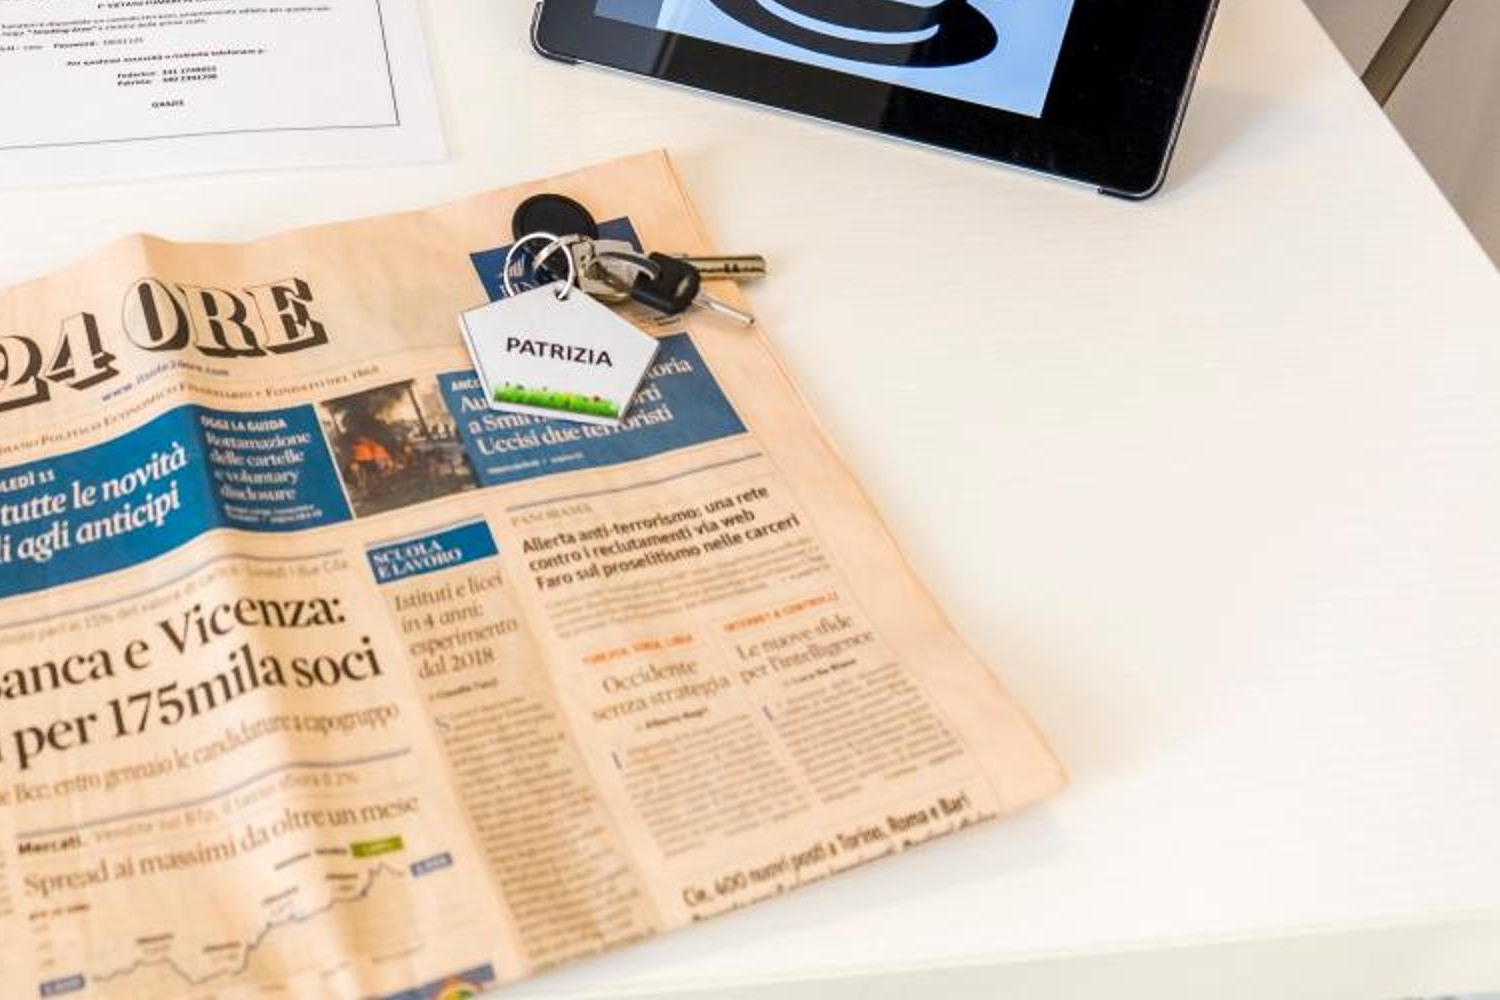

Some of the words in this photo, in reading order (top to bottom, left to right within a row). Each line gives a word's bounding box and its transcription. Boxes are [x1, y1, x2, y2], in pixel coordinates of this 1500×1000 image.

[122, 276, 328, 358] ORE
[506, 337, 613, 367] PATRIZIA
[201, 415, 229, 430] OGGI
[231, 418, 245, 430] LA
[247, 417, 288, 431] GUIDA
[468, 421, 483, 435] a
[205, 431, 311, 450] Rottamazione
[210, 448, 244, 466] delle
[246, 449, 305, 466] cartelle
[477, 432, 541, 456] Uccisi
[542, 426, 580, 445] due
[0, 488, 66, 527] tutte
[72, 480, 97, 509] le
[102, 441, 188, 501] novità
[39, 470, 55, 484] 11
[220, 486, 296, 501] disclosure
[226, 469, 299, 486] voluntary
[17, 521, 69, 562] agli
[76, 480, 180, 545] anticipi
[510, 503, 594, 528] PANORAMA
[522, 531, 576, 553] Allerta
[578, 507, 702, 543] anti-terrorismo:
[705, 497, 734, 514] una
[737, 485, 769, 505] rete
[373, 539, 443, 563] SCUOLA
[529, 551, 582, 573] contro
[592, 527, 692, 558] reclutamenti
[695, 519, 719, 535] via
[722, 509, 755, 528] web
[536, 574, 573, 591] Faro
[575, 563, 600, 580] sul
[602, 544, 701, 579] proselitismo
[703, 533, 744, 554] nelle
[745, 512, 800, 541] carceri
[377, 564, 390, 579] E
[393, 548, 463, 575] LAVORO
[395, 583, 453, 611] Istituti
[455, 585, 466, 596] e
[468, 570, 503, 595] licei
[125, 637, 149, 670] e
[158, 596, 346, 655] Vicenza:
[402, 615, 421, 634] in
[424, 613, 435, 629] 4
[410, 618, 518, 657] esperimento
[736, 643, 760, 661] Le
[762, 630, 812, 654] nuove
[816, 613, 853, 636] sfide
[419, 654, 447, 679] dal
[451, 647, 495, 673] 2018
[602, 659, 698, 694] Occidente
[739, 665, 769, 686] per
[13, 711, 97, 770] per
[107, 644, 285, 738] 175mila
[292, 636, 383, 689] soci
[593, 696, 648, 721] senza
[650, 674, 730, 706] strategia
[53, 770, 100, 795] entro
[104, 760, 173, 791] gennaio
[174, 747, 191, 770] le
[193, 714, 293, 764] candidature
[303, 703, 400, 737] capogruppo
[18, 834, 84, 856] Mercati.
[23, 858, 109, 898] Spread
[114, 857, 135, 878] ai
[140, 839, 236, 875] massimi
[241, 824, 270, 851] da
[272, 803, 324, 838] oltre
[325, 804, 356, 826] un
[360, 796, 419, 822] mese
[749, 856, 789, 882] nuovi
[791, 843, 827, 871] posti
[886, 812, 929, 832] Roma
[939, 791, 970, 815] Bari
